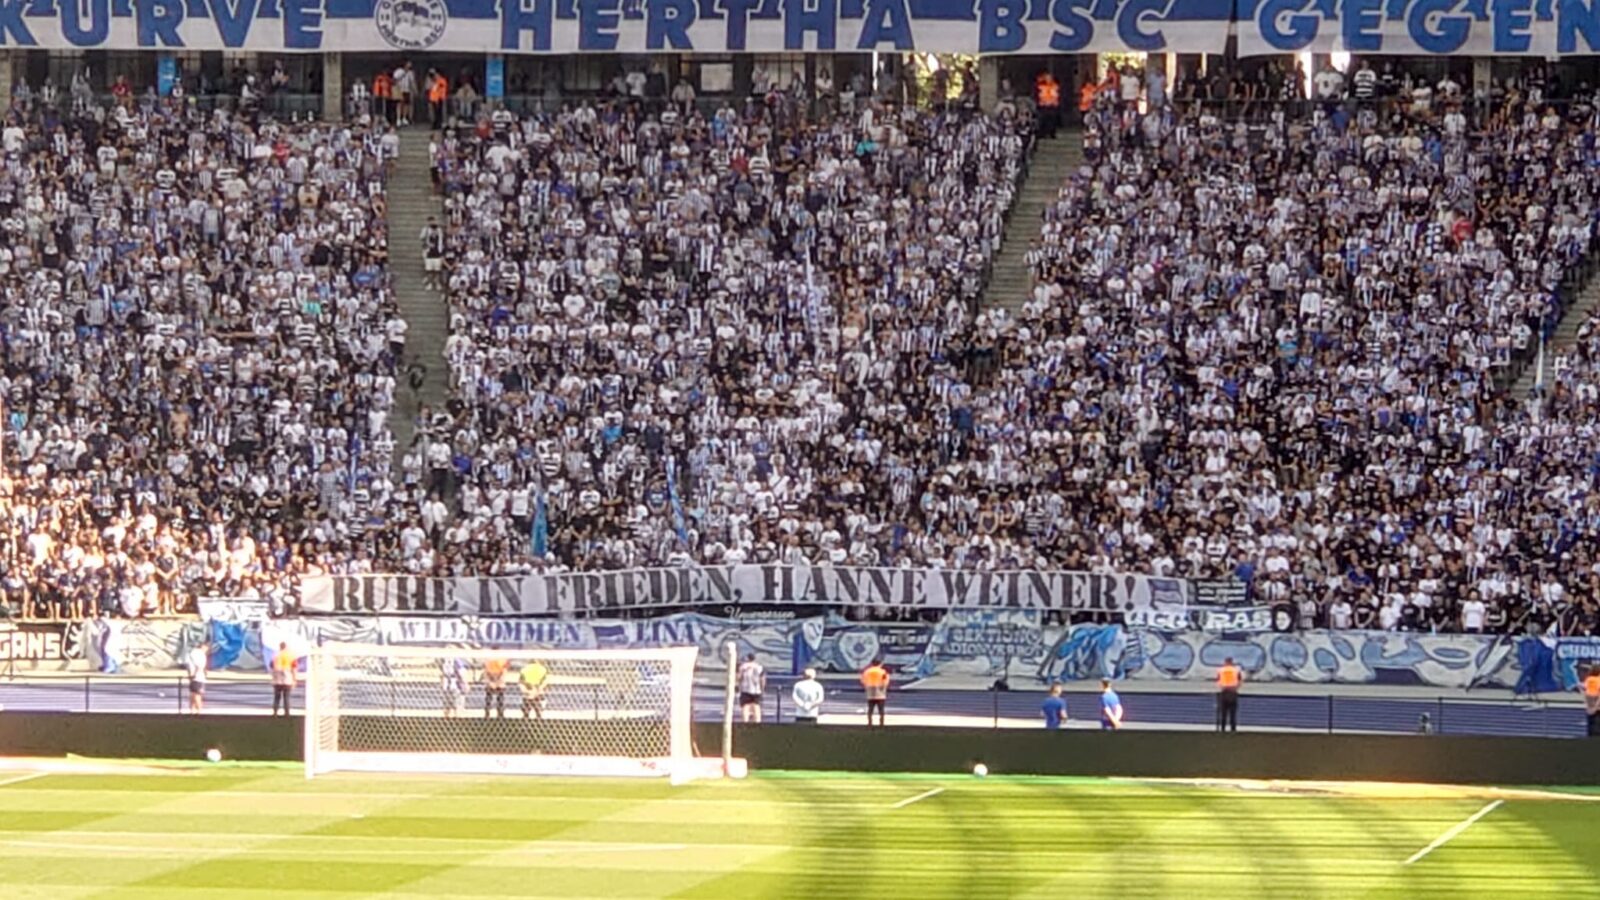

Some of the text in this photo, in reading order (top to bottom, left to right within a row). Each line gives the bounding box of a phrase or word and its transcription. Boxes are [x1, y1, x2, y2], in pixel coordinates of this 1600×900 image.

[499, 0, 914, 50] HERTHA
[978, 0, 1172, 52] BSC
[332, 564, 1137, 613] RUHE IN FRIEDEN, HANNE WEINER!
[398, 619, 582, 643] WILLKOMMEN
